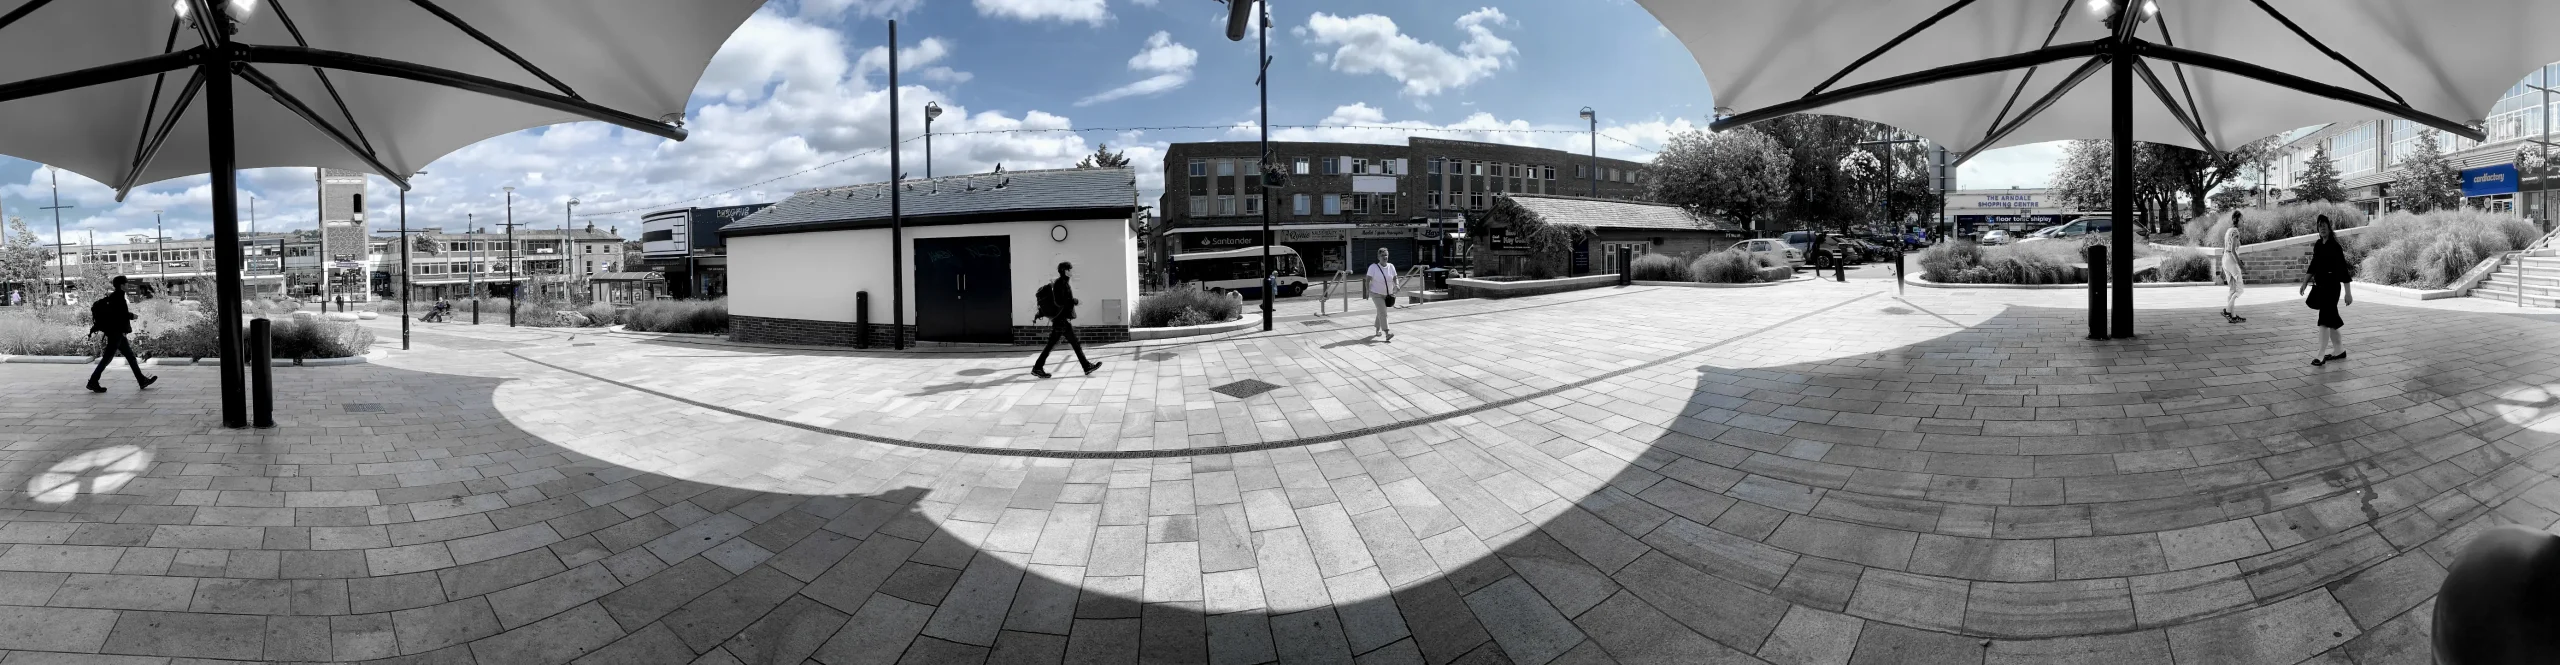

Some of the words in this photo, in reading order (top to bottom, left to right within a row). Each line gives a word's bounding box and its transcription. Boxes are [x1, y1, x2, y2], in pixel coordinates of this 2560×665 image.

[2473, 172, 2505, 183] cardfactory
[2030, 215, 2052, 223] shipley
[1212, 237, 1252, 245] Santander
